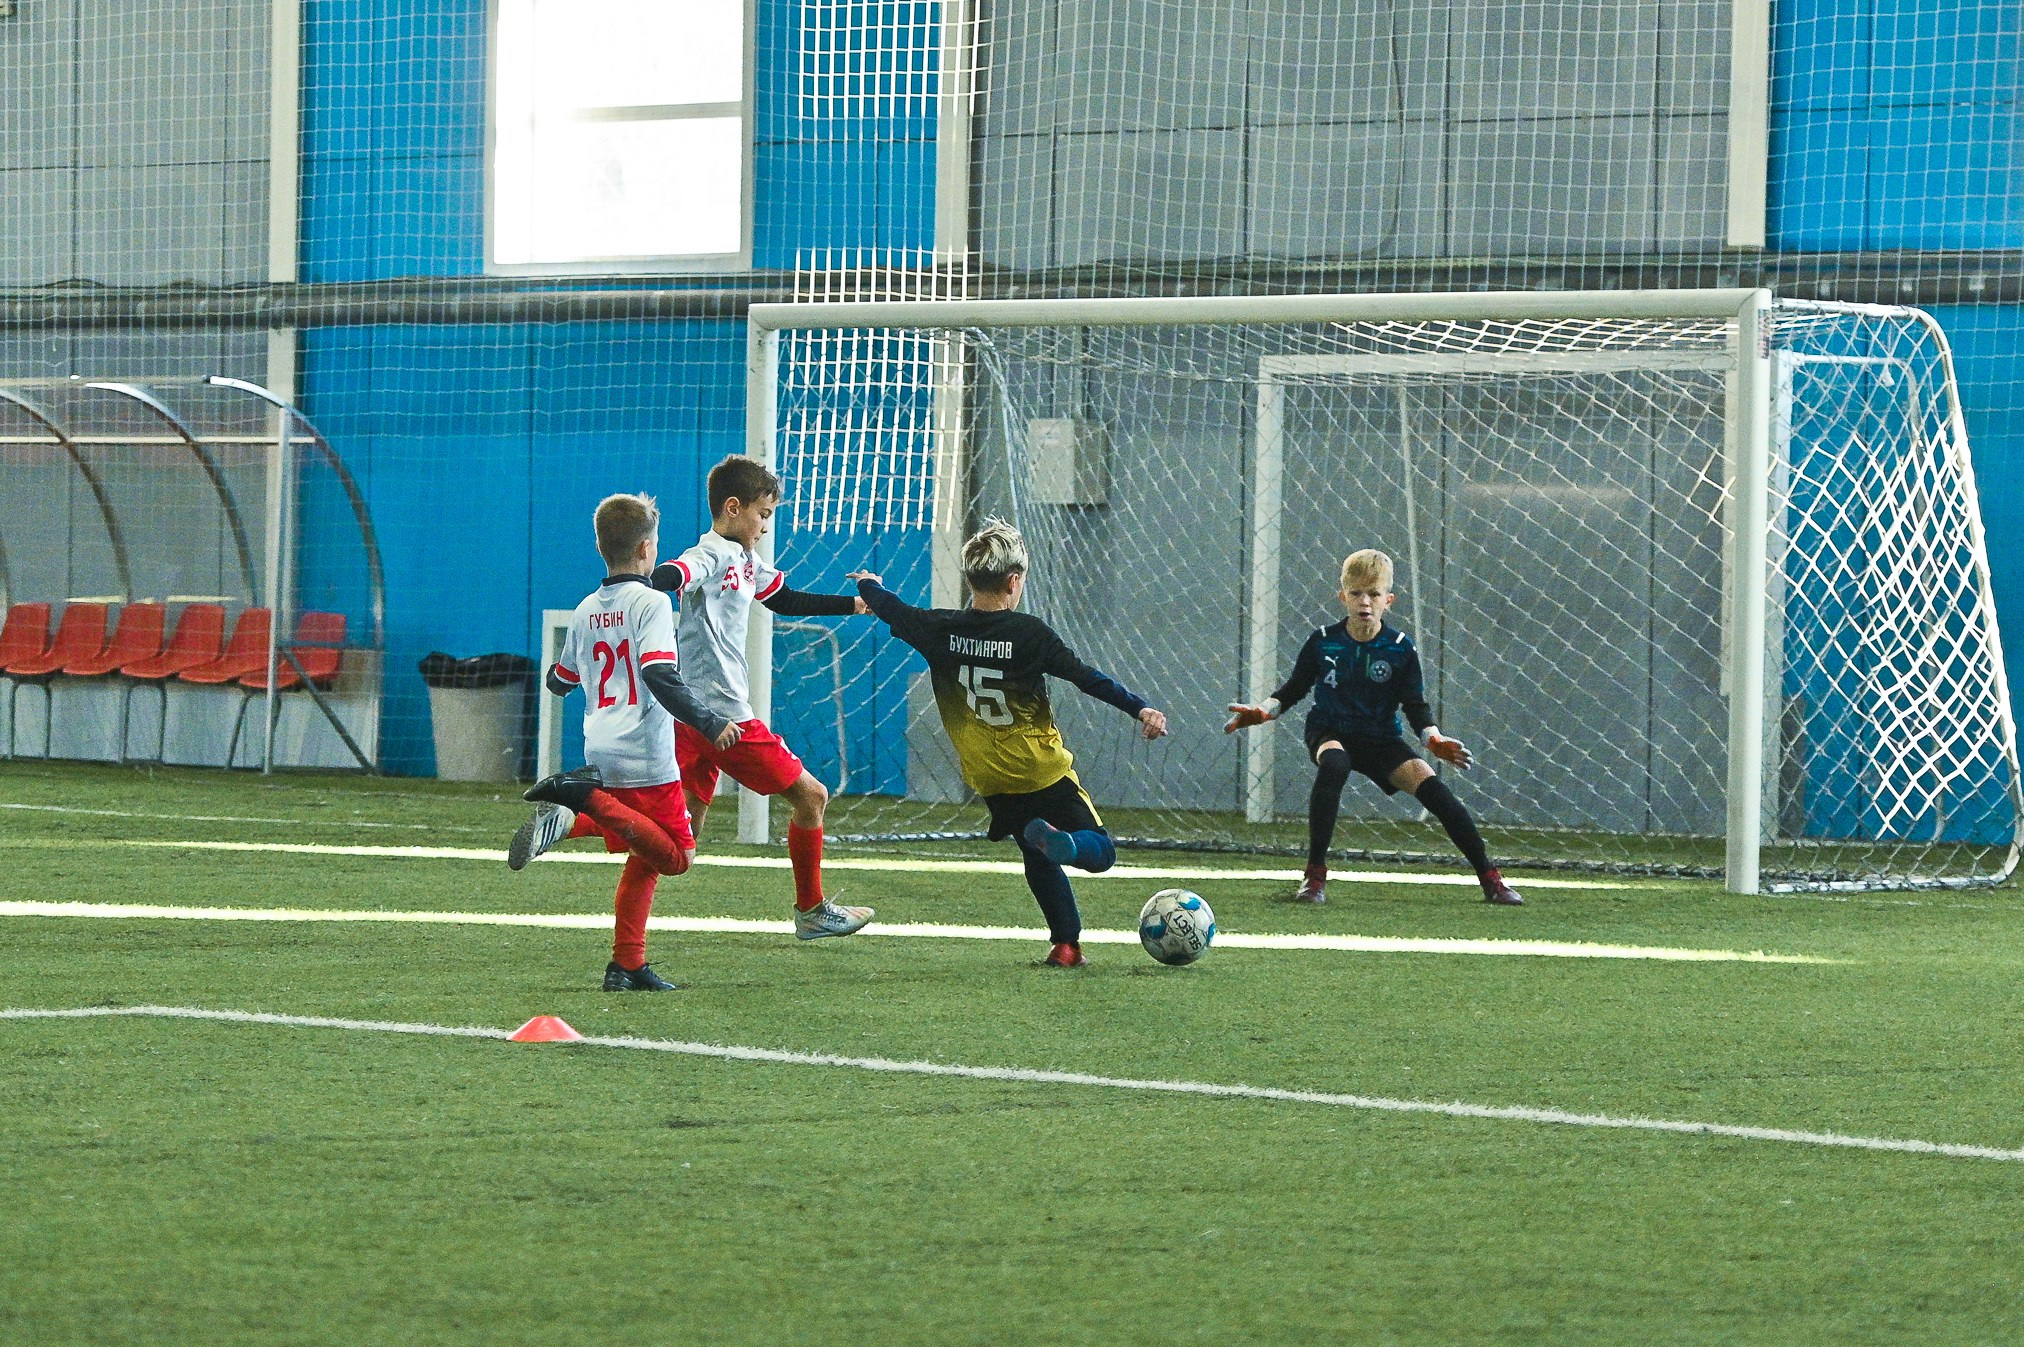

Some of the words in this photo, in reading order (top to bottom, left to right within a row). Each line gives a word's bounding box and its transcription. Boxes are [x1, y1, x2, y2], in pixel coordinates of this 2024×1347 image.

[589, 611, 624, 630] ГУБИН
[949, 634, 1013, 659] БУХТИЯРОВ
[592, 638, 637, 709] 21
[1323, 669, 1338, 688] 4
[958, 664, 1014, 726] 15
[1173, 914, 1202, 951] SELECT
